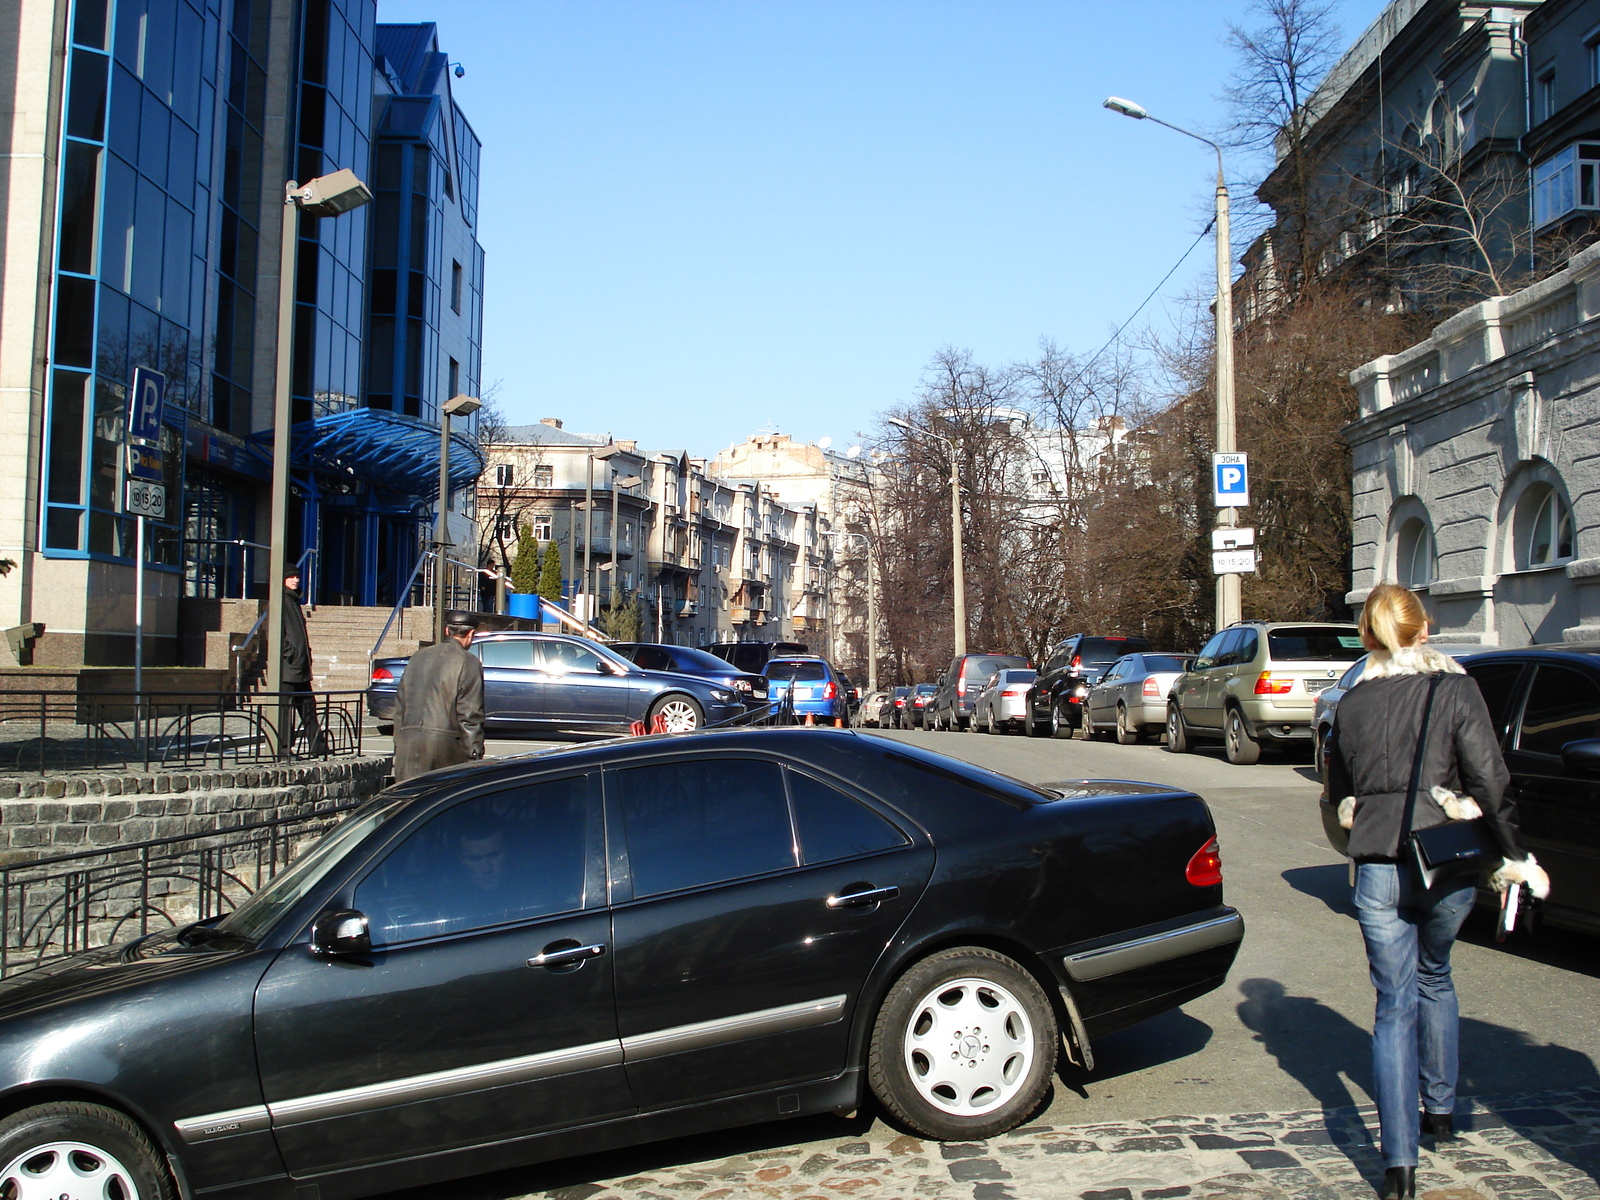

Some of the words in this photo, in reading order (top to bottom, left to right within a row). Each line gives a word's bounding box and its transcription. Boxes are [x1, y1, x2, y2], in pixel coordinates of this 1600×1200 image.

[140, 378, 159, 431] P
[131, 448, 141, 472] P
[1221, 455, 1241, 464] ЗОНА
[1222, 467, 1242, 491] P
[133, 492, 140, 502] 10
[141, 493, 149, 504] 15
[151, 495, 162, 507] 20
[1228, 558, 1236, 566] 15
[1238, 557, 1251, 566] 20
[203, 1123, 240, 1134] ELEGANCE
